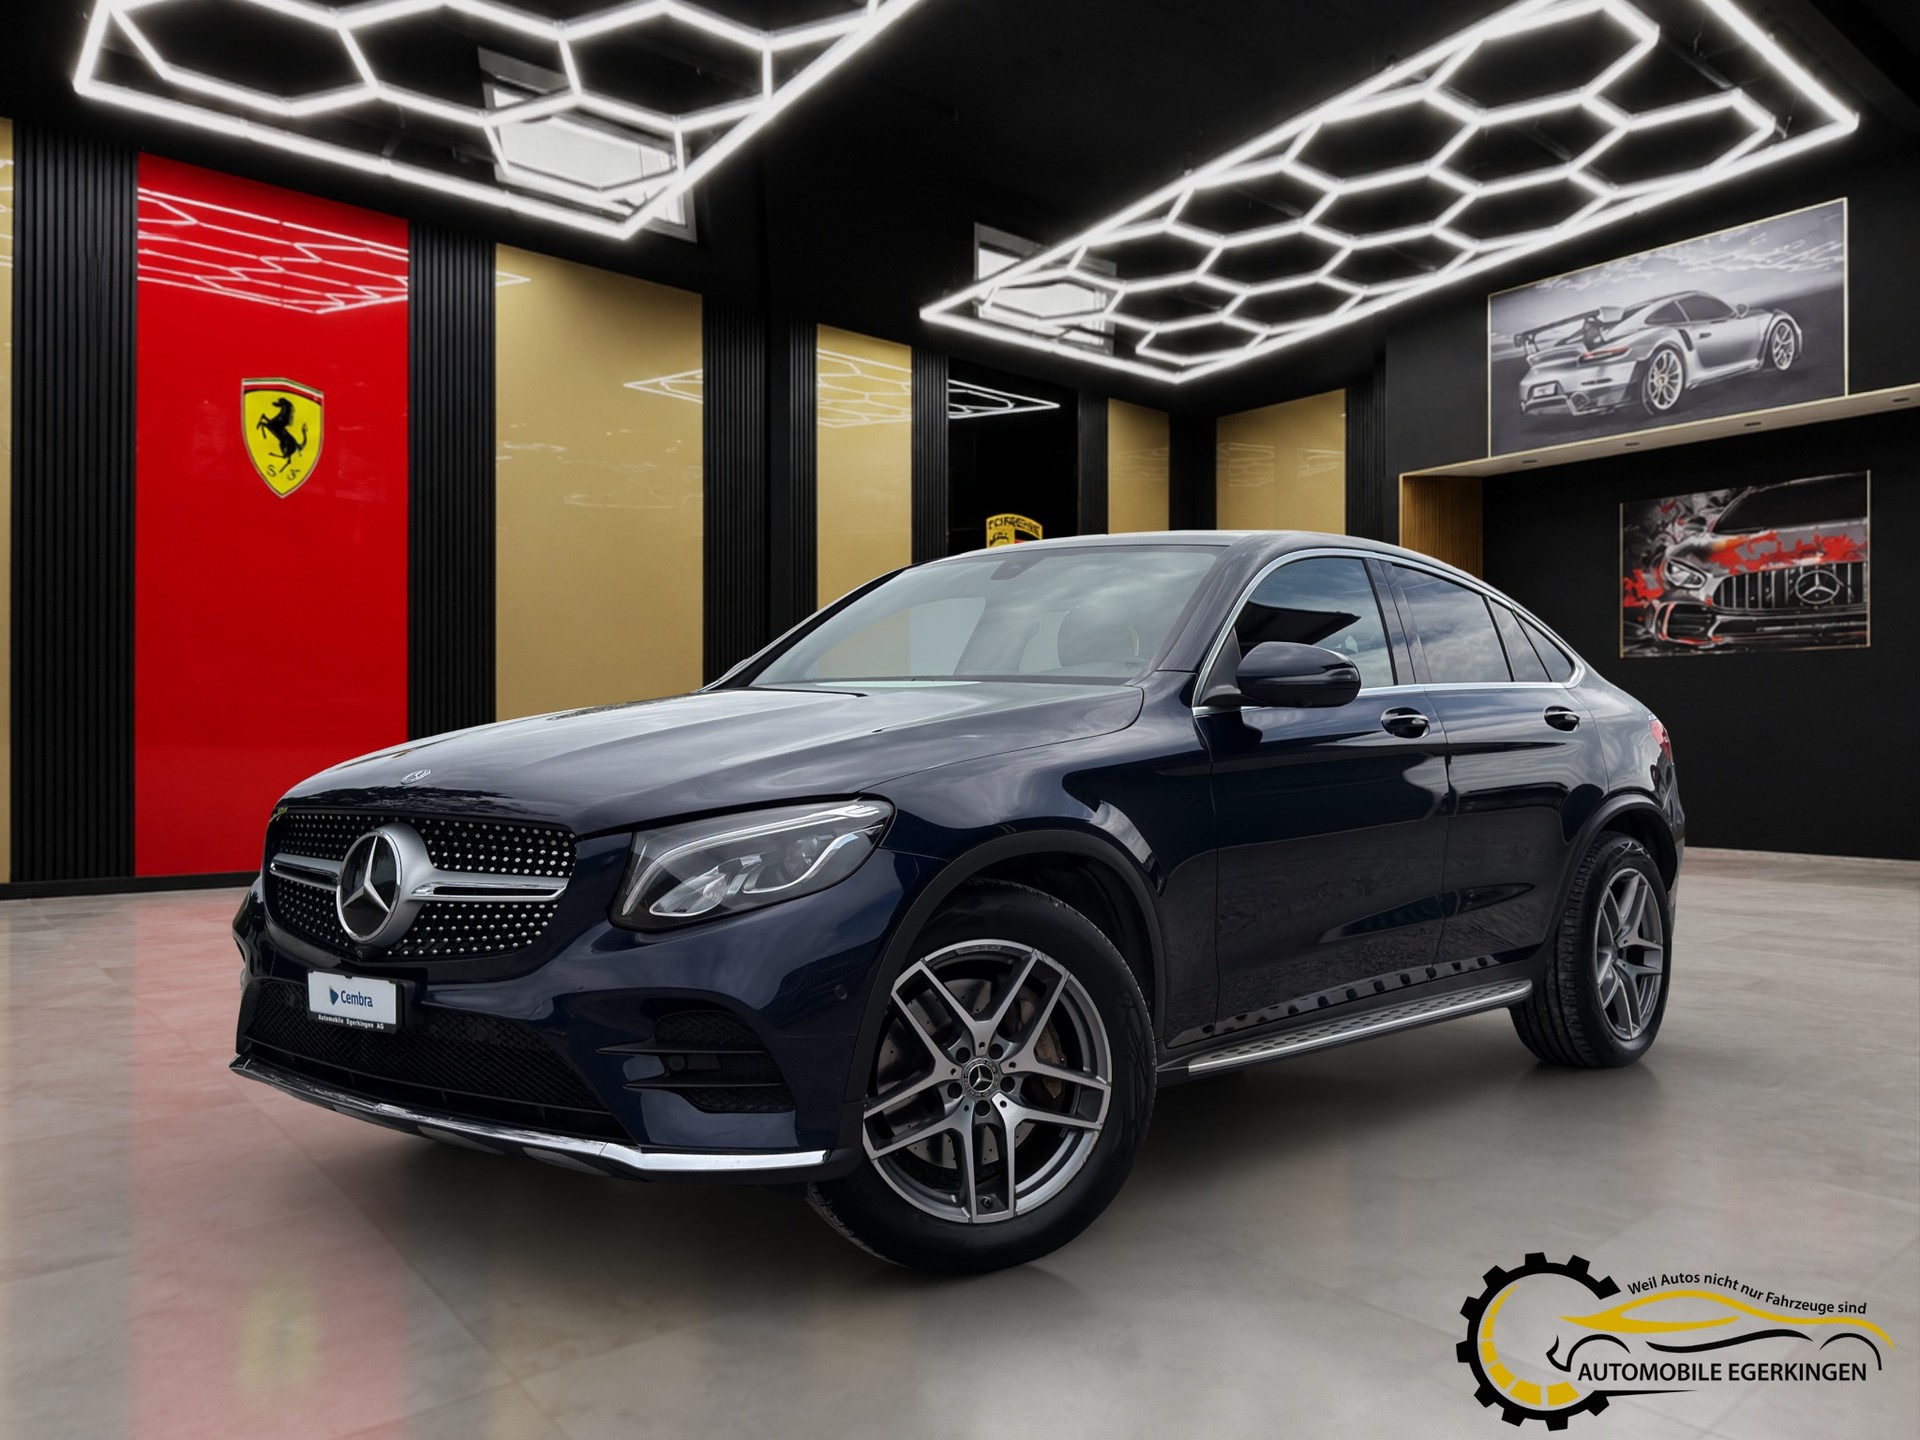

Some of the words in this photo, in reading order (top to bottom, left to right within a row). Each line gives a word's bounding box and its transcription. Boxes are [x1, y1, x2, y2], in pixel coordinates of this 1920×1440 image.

[340, 990, 374, 1008] Cembra
[318, 1014, 344, 1024] Automobile
[346, 1018, 374, 1028] Egerkingen
[376, 1022, 384, 1030] AG
